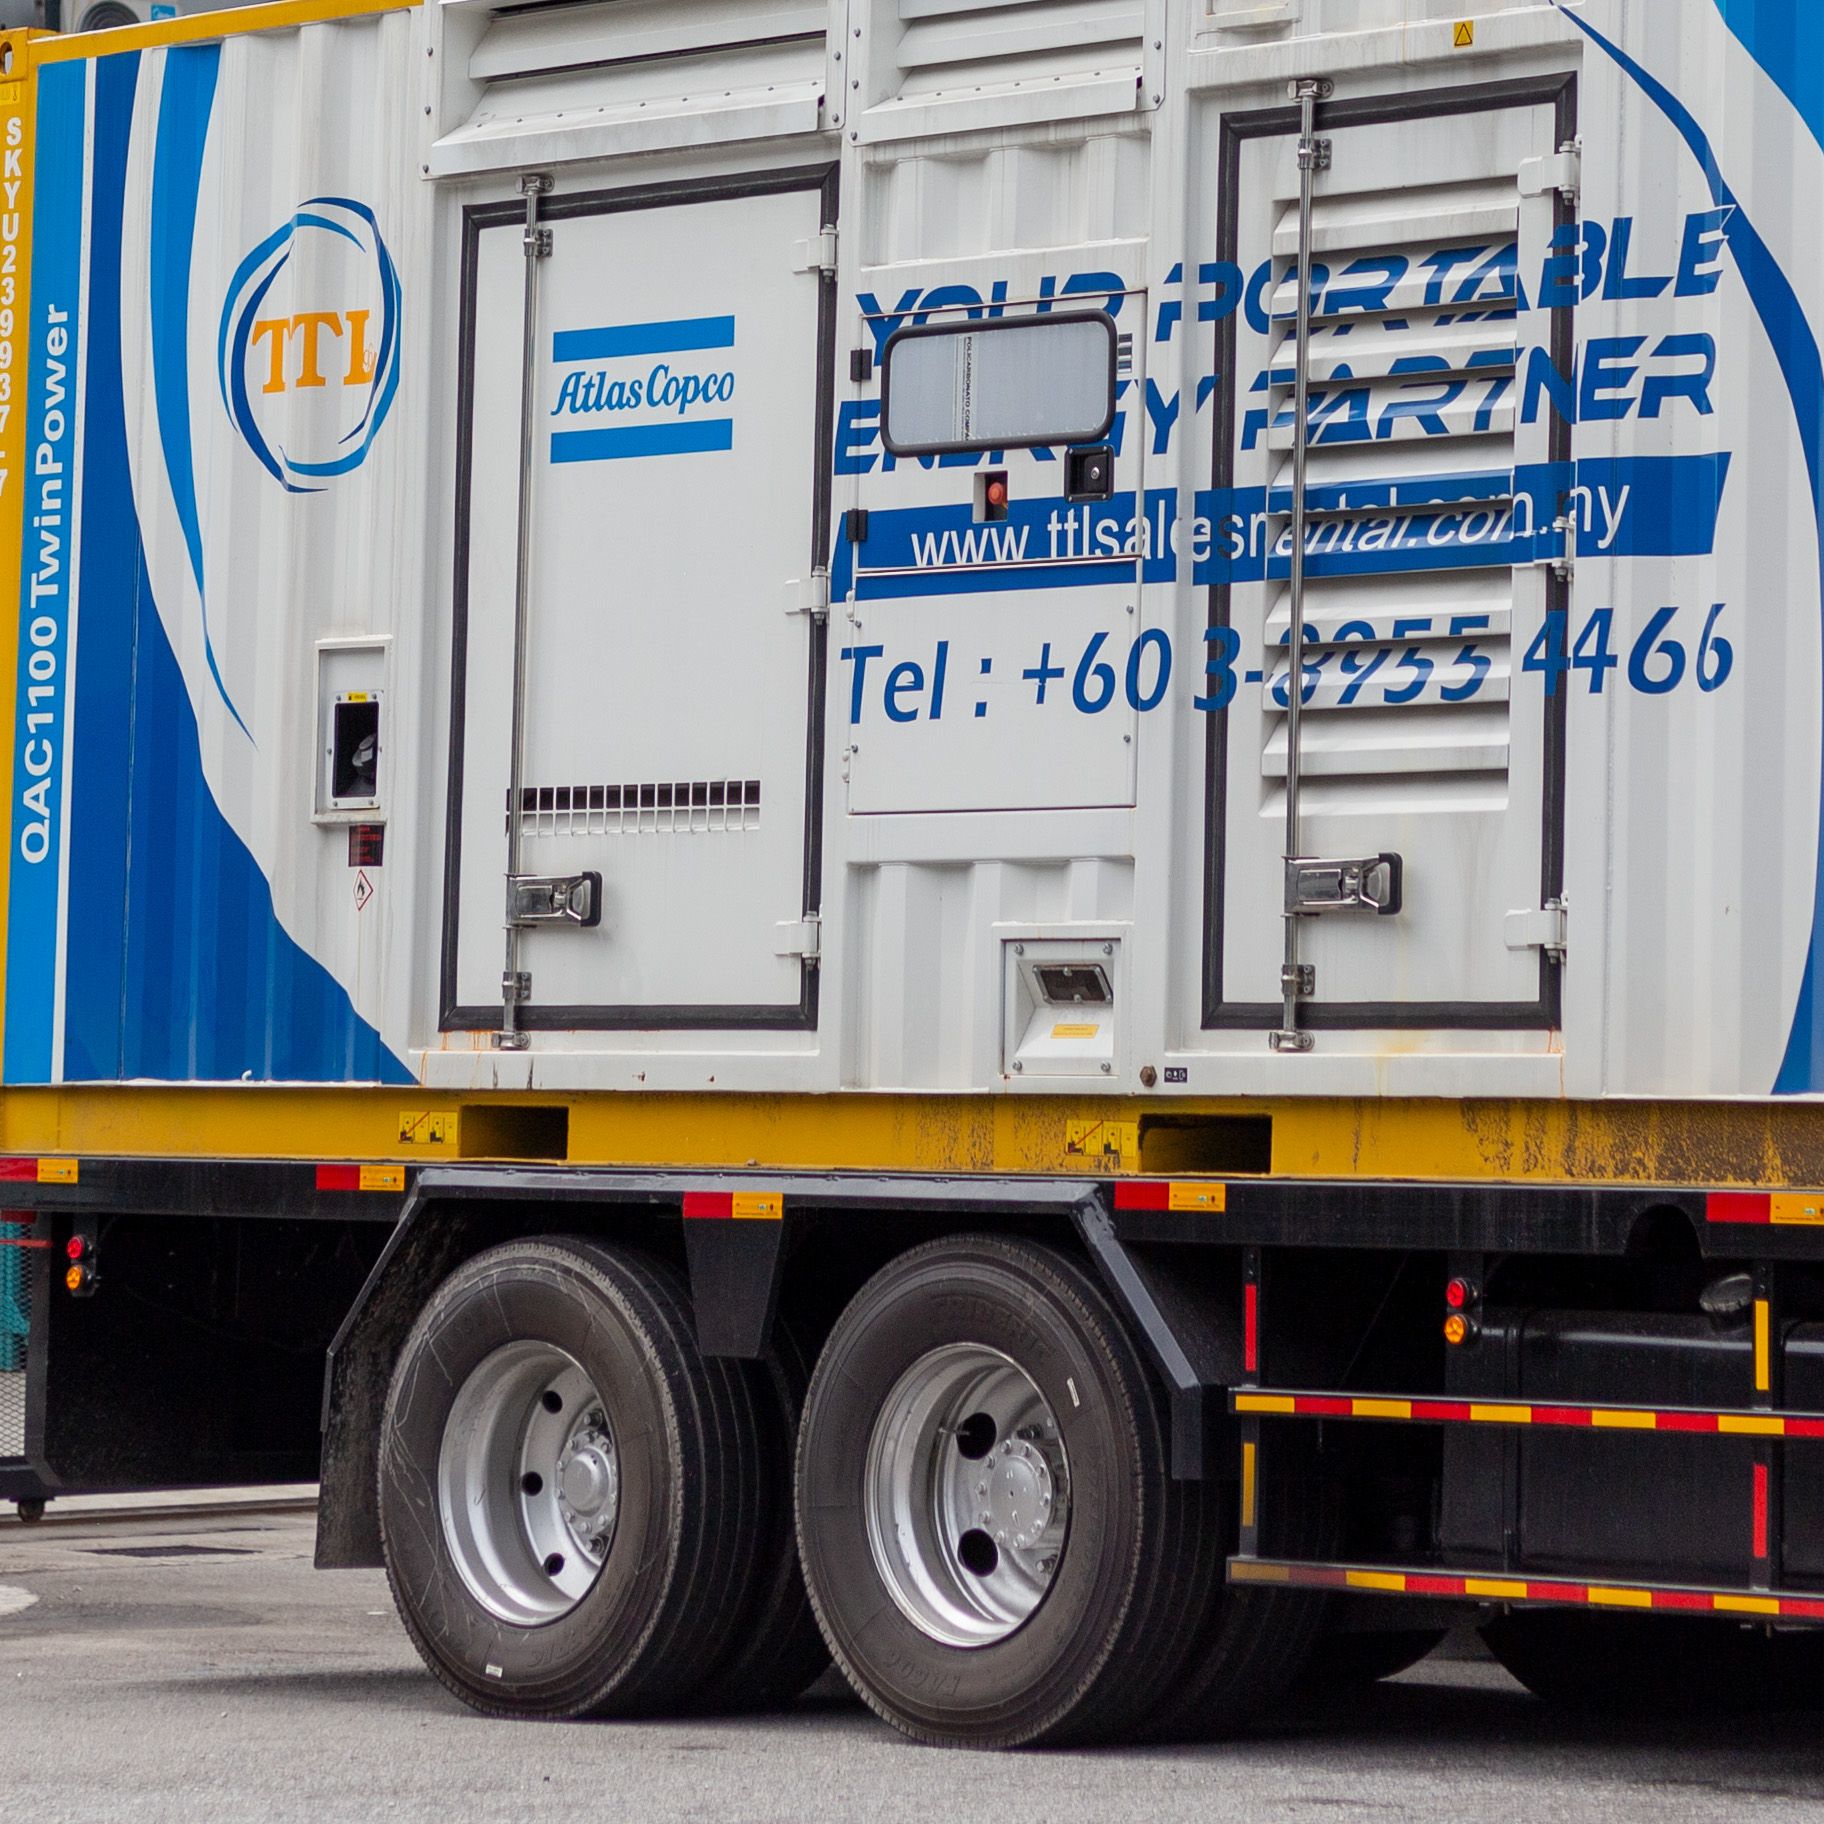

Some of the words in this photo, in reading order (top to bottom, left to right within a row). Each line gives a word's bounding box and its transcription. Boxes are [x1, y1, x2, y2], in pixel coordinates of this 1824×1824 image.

[251, 309, 377, 394] TTL
[30, 304, 68, 608] TwinPower
[21, 616, 58, 864] QAC1100
[840, 640, 949, 724] Tel
